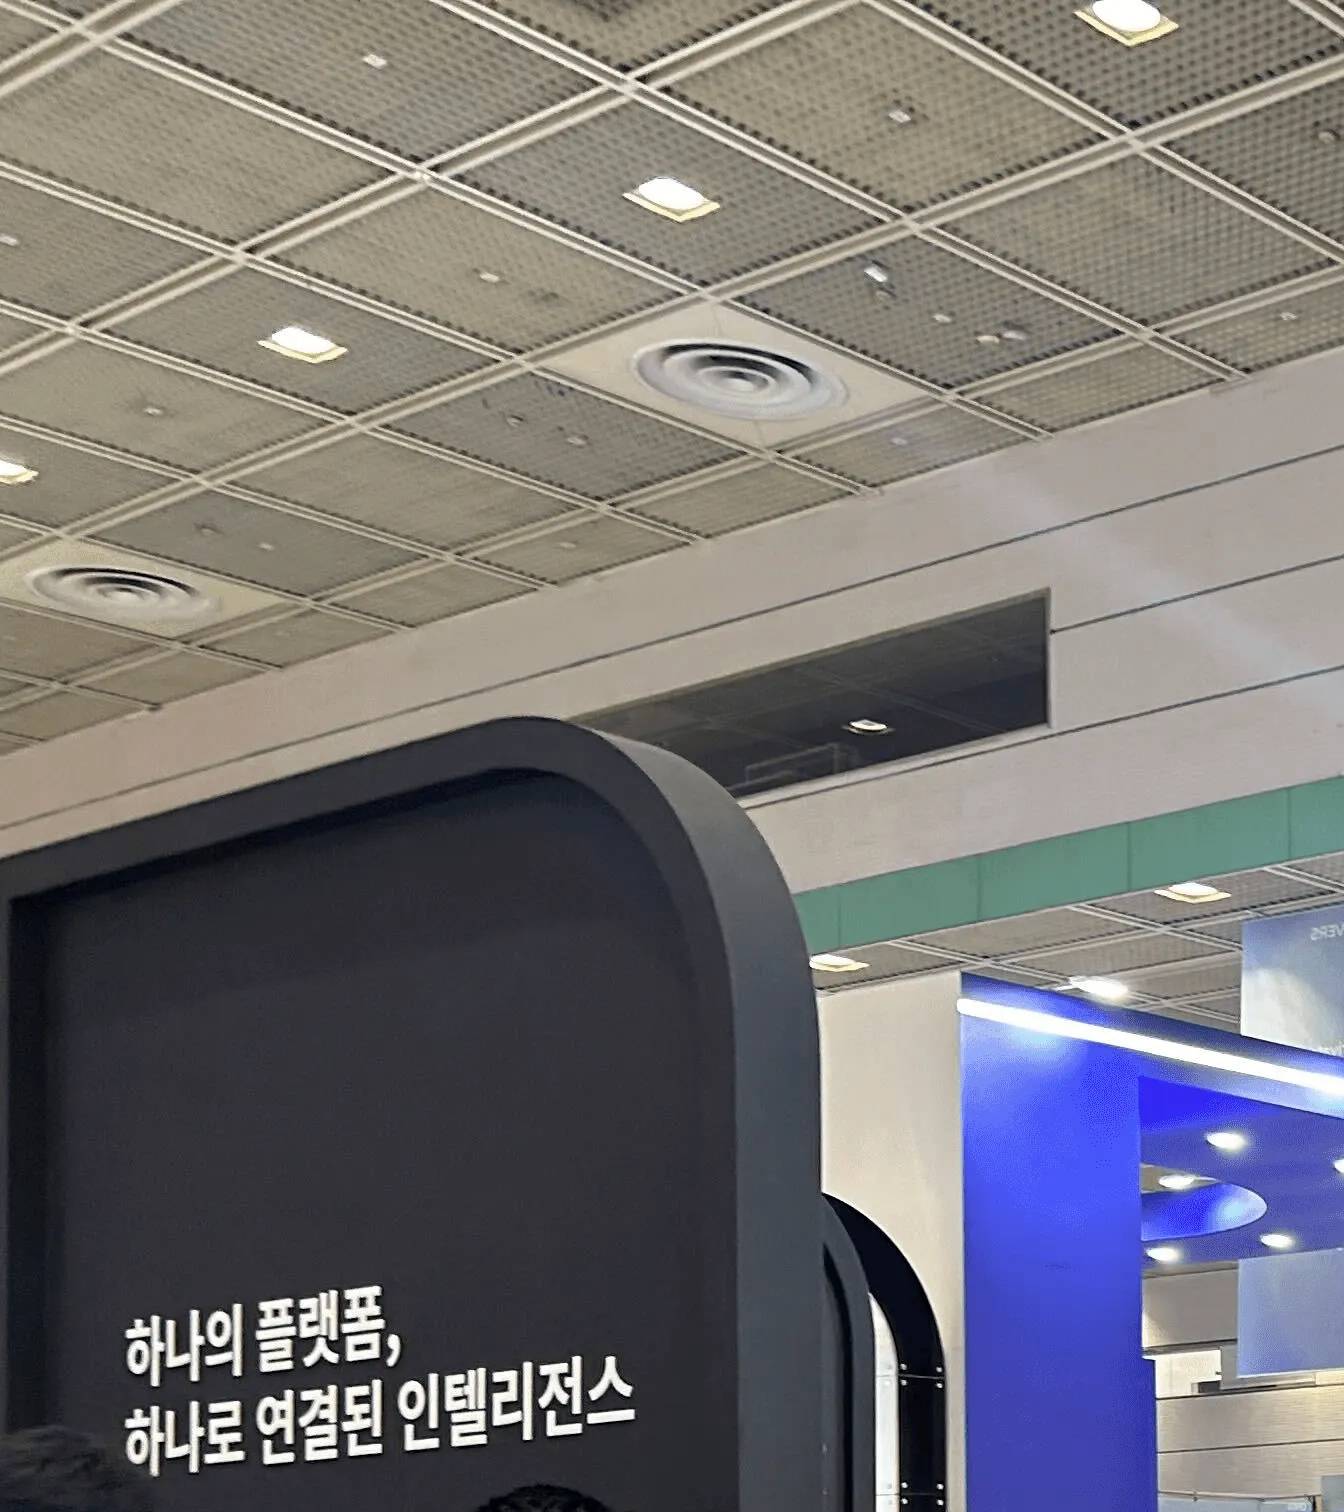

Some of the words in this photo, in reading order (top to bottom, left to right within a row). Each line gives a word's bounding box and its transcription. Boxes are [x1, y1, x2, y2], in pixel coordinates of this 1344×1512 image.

[125, 1304, 243, 1387] 하나의
[256, 1285, 401, 1373] 플랫폼,
[124, 1400, 246, 1477] 하나로
[256, 1379, 384, 1465] 연결된
[398, 1355, 635, 1452] 인텔리전스
